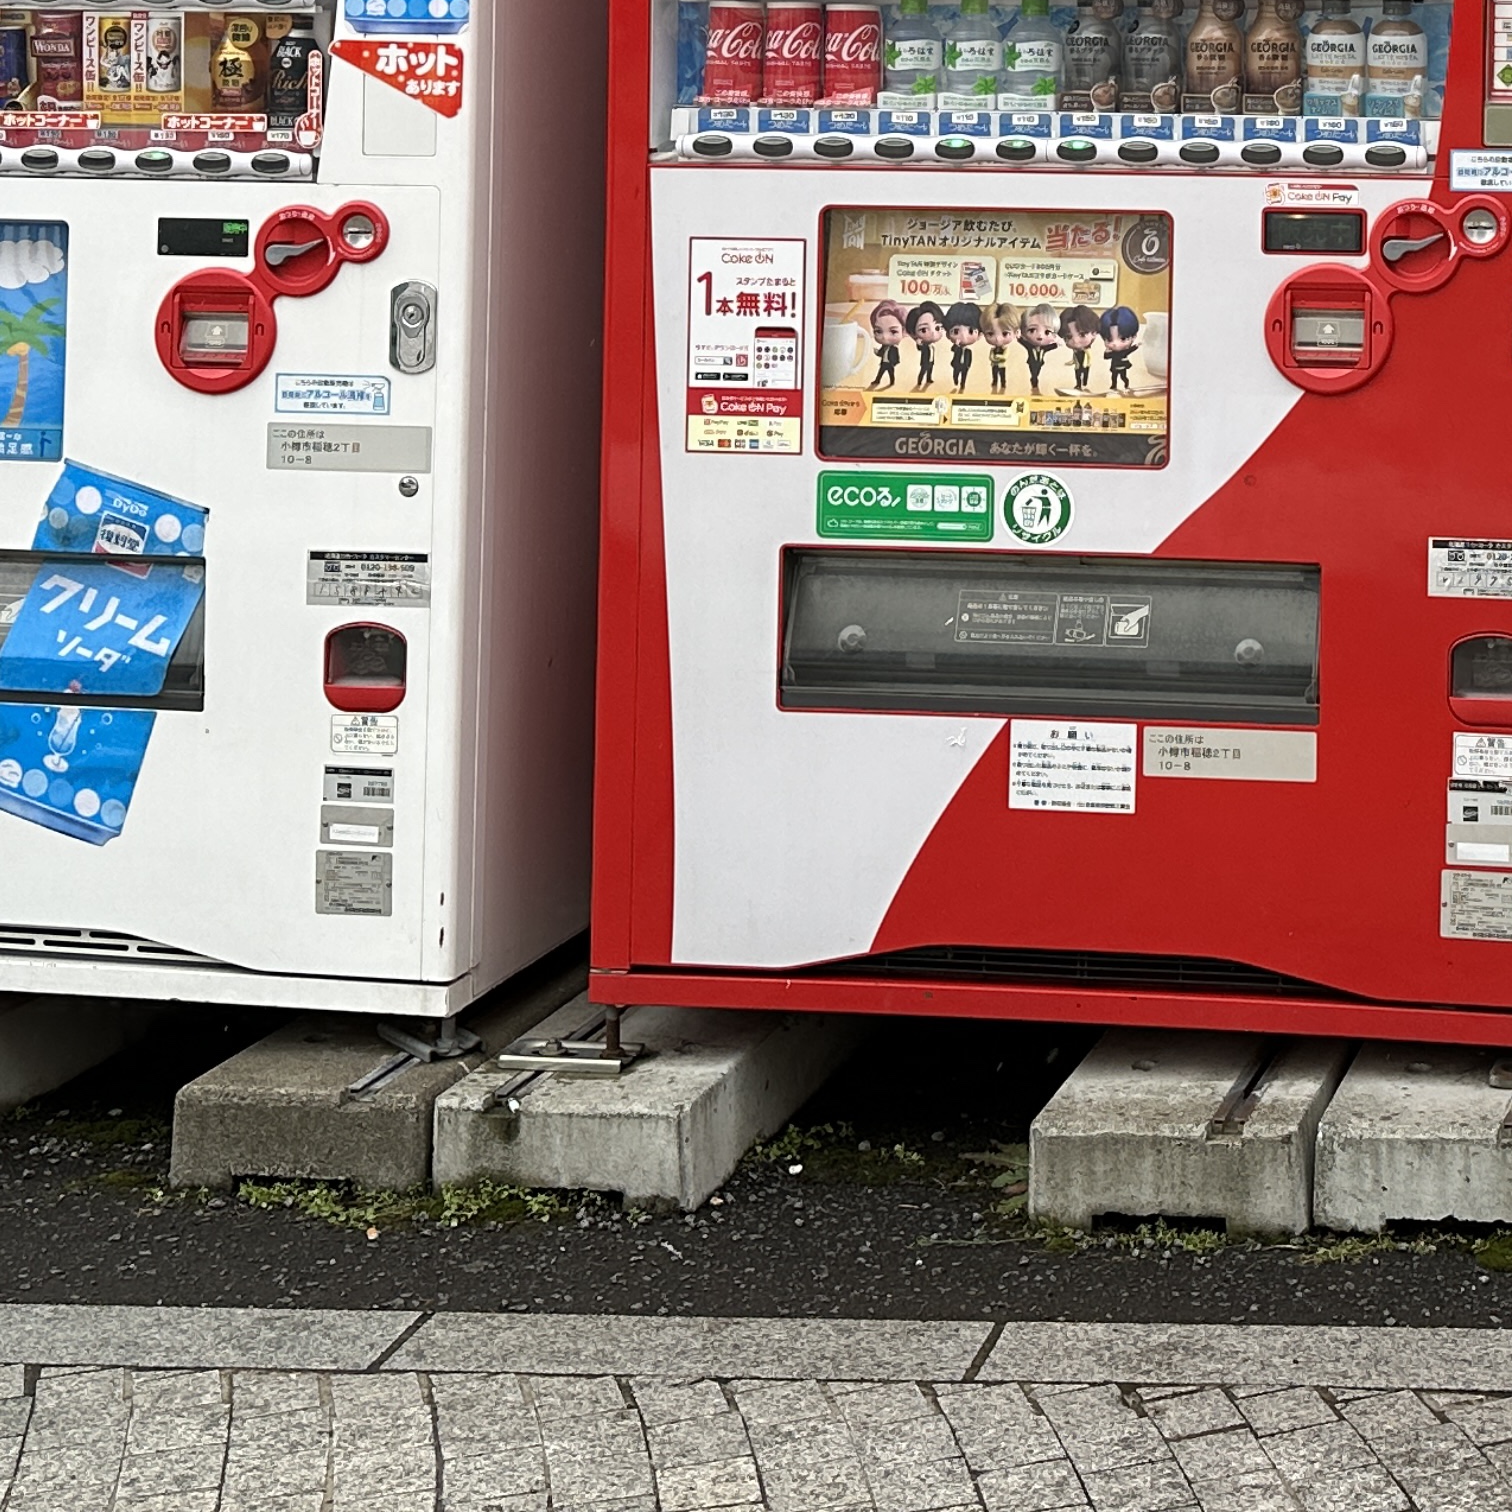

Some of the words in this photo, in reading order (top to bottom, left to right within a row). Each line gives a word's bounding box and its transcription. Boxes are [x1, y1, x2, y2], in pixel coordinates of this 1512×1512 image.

[34, 40, 71, 54] WONDA
[276, 46, 302, 58] BLACK
[1189, 39, 1235, 54] GEORGIA
[1250, 39, 1297, 54] GEORGIA
[1310, 39, 1355, 54] GEORGIA
[1372, 40, 1418, 55] GEORGIA
[376, 48, 458, 75] ホット
[405, 80, 461, 96] あります
[3, 114, 83, 127] ホットコーナー
[167, 116, 249, 129] ホットコーナー
[1286, 190, 1314, 202] Coke
[1331, 192, 1353, 205] Pay
[906, 217, 1017, 233] ジョージア飲むたび。
[880, 234, 1042, 250] TinyTANオリジナルアイテム
[1045, 216, 1121, 253] 当たる!
[721, 253, 753, 265] Coke
[755, 252, 774, 264] ON
[735, 276, 797, 287] スタンプたまると
[696, 271, 797, 319] 1本無料!
[720, 401, 748, 413] Coke
[747, 400, 766, 412] ON
[766, 402, 787, 416] Pay
[894, 433, 977, 456] GEORGIA
[989, 443, 1099, 458] あなたが輝く一杯を。
[112, 497, 147, 517] DyDo
[38, 573, 171, 659] クリーム
[55, 628, 132, 673] ソーダ
[1148, 733, 1205, 745] ここの住所は
